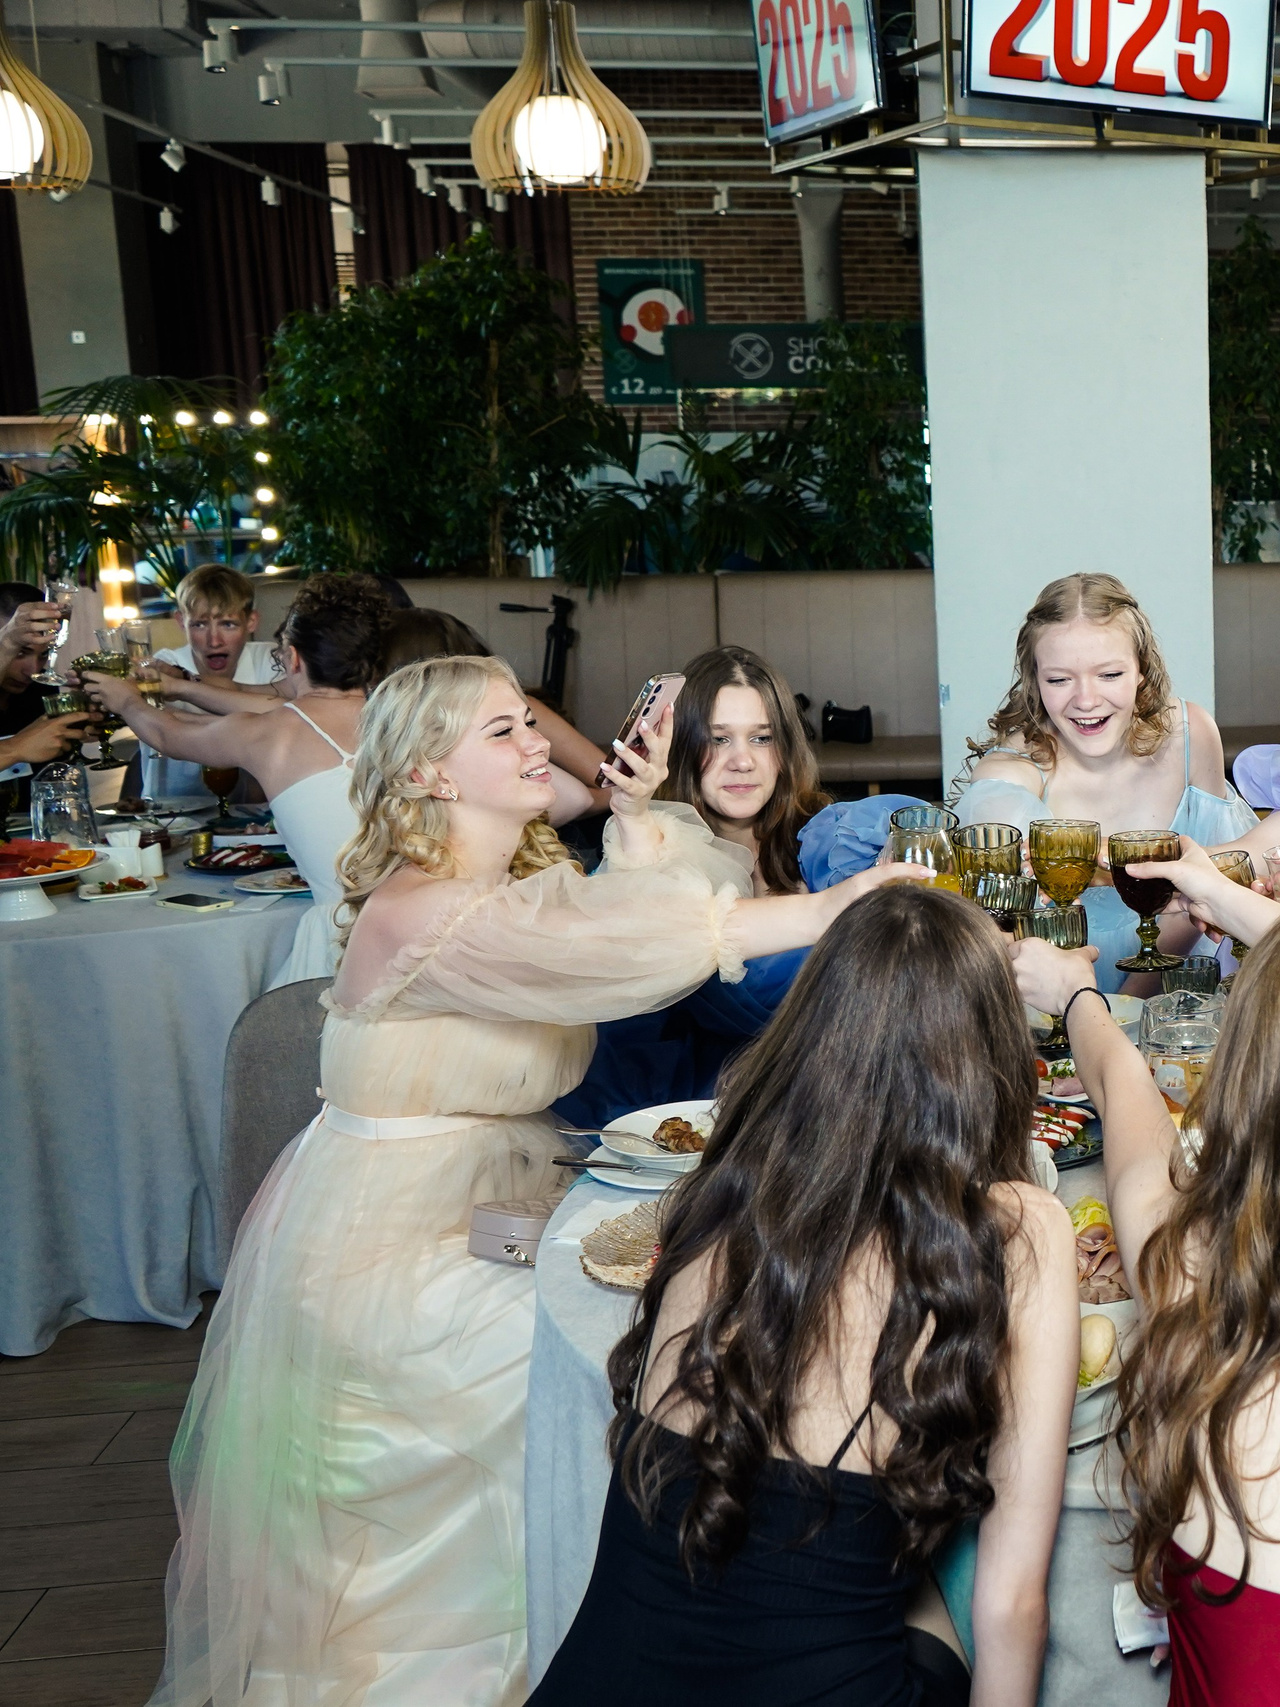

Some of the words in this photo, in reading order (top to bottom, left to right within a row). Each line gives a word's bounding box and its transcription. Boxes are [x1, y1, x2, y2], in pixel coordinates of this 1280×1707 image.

[758, 0, 857, 128] 2025
[989, 0, 1230, 101] 2025
[620, 377, 646, 395] 12
